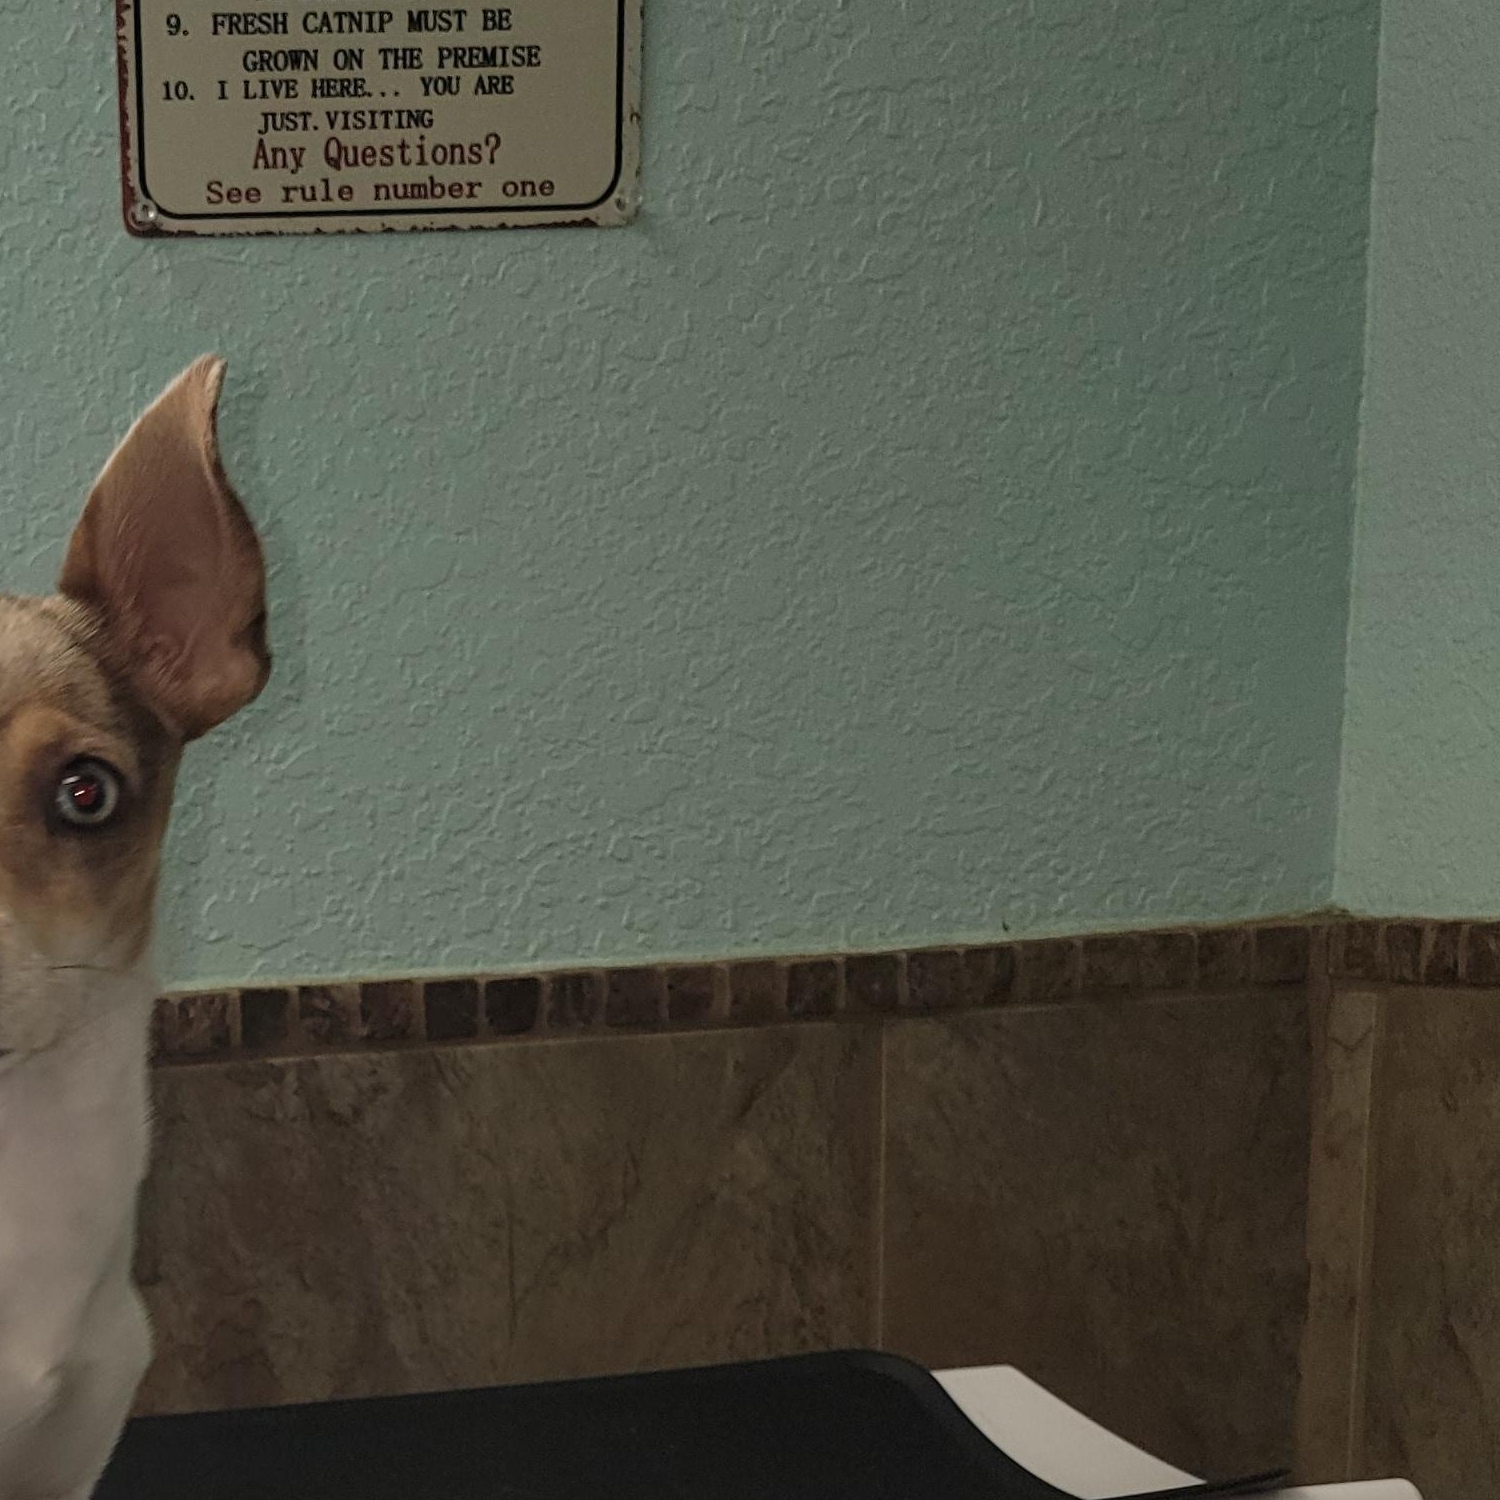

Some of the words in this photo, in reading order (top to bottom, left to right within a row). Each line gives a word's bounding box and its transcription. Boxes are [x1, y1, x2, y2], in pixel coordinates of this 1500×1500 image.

[166, 13, 189, 36] 9.
[212, 12, 288, 36] FRESH
[302, 10, 393, 34] CATNIP
[407, 9, 467, 32] MUST
[482, 8, 512, 31] BE
[243, 49, 319, 72] GROWN
[333, 48, 364, 71] ON
[379, 47, 423, 70] THE
[438, 45, 541, 68] PREMISE
[162, 80, 195, 100] 10.
[218, 80, 228, 100] I
[243, 79, 299, 99] LIVE
[420, 75, 460, 96] YOU
[474, 74, 514, 95] ARE
[325, 109, 434, 131] VISITING
[252, 137, 306, 174] Any
[324, 131, 501, 171] Questions?
[206, 180, 261, 204] See
[281, 177, 353, 203] rule
[373, 175, 483, 201] number
[502, 179, 555, 198] one
